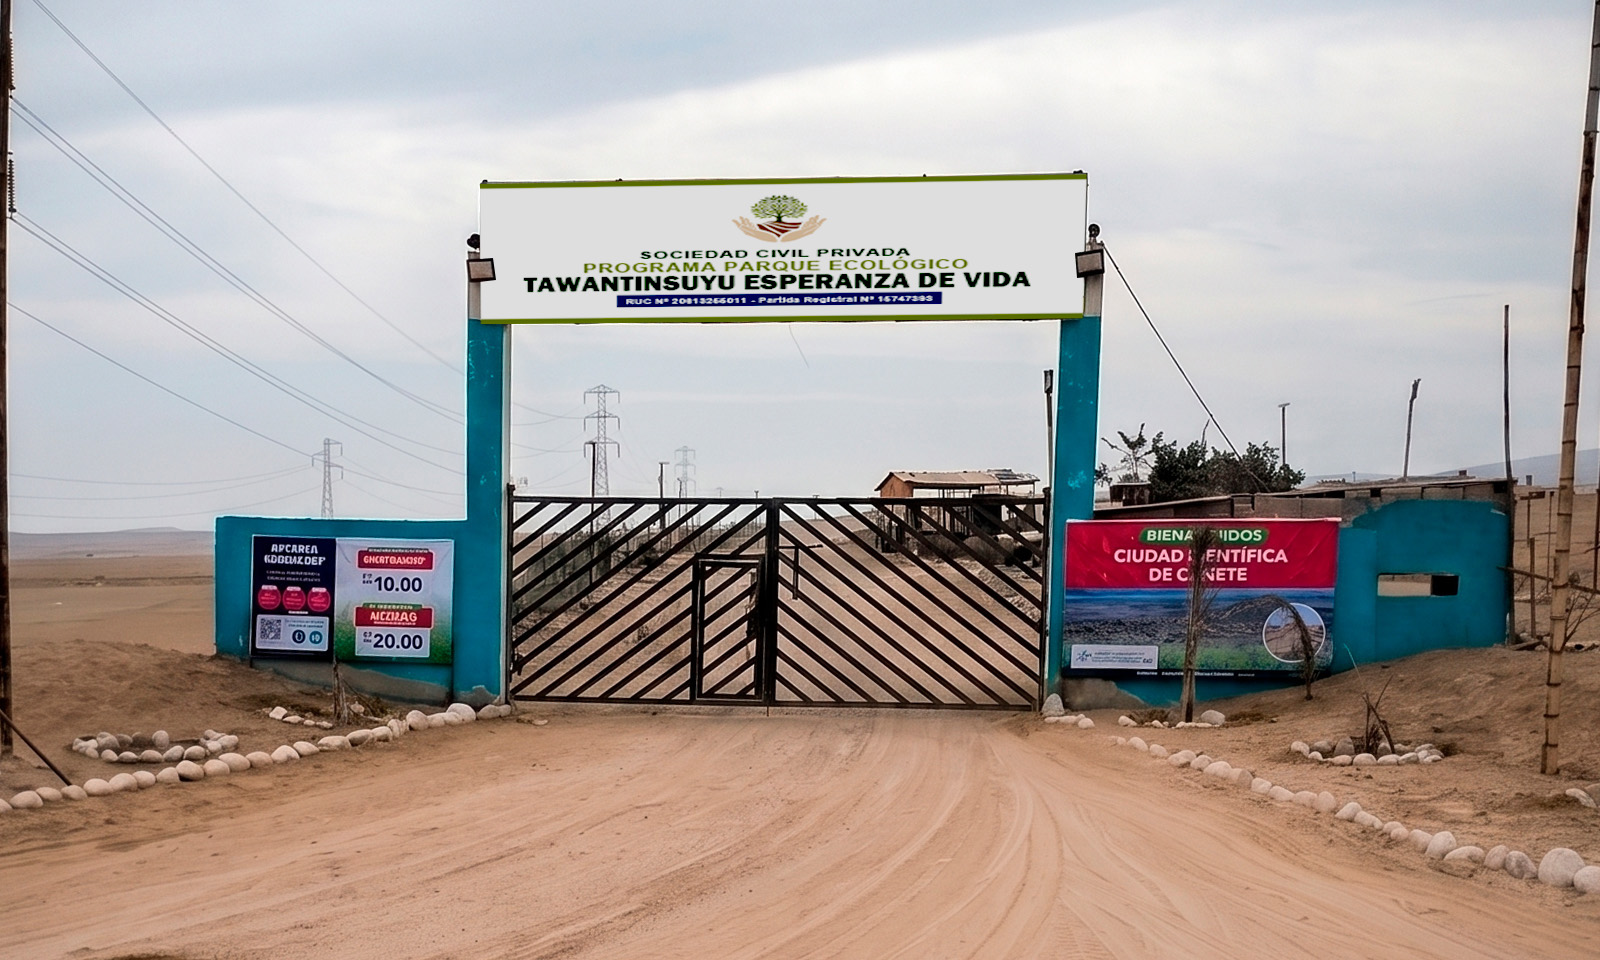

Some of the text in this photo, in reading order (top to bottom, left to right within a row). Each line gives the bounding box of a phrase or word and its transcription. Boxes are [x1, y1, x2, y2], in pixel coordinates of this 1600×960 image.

[640, 248, 910, 260] SOCIEDAD CIVIL PRIVADA
[583, 256, 968, 274] PROGRAMA PARQUE ECOLÓGICO
[523, 271, 1031, 292] TAWANTINSUYU ESPERANZA DE VIDA
[758, 295, 801, 304] Partida
[803, 294, 858, 304] Registral
[1113, 548, 1184, 563] CIUDAD
[1149, 567, 1173, 582] DE
[374, 576, 423, 592] 10.00
[373, 633, 423, 650] 20.00
